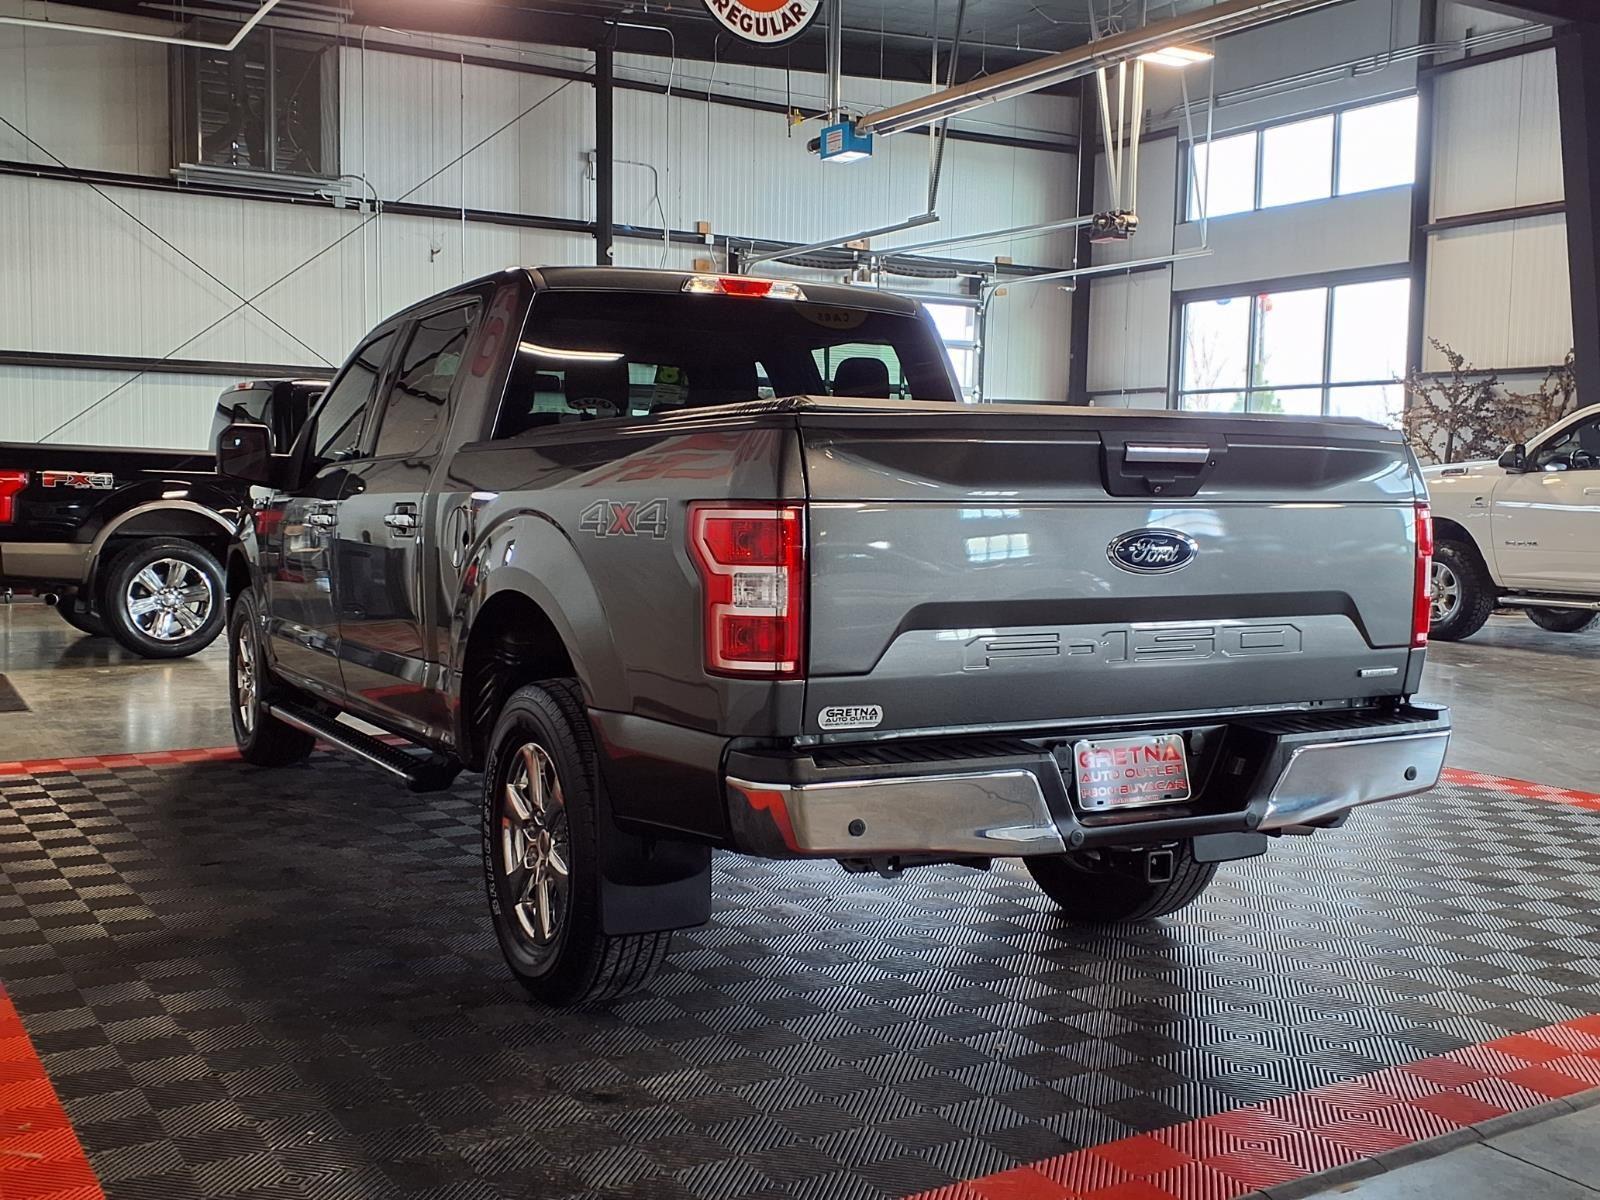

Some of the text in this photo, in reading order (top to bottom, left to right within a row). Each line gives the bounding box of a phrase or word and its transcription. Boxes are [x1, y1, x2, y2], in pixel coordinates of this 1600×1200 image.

[713, 0, 807, 37] REGULAR
[1131, 538, 1180, 563] Ford
[963, 622, 1303, 672] F-150
[826, 707, 878, 718] GRETNA
[1079, 743, 1183, 769] GRETNA
[1081, 763, 1183, 784] AUTO OUTLET
